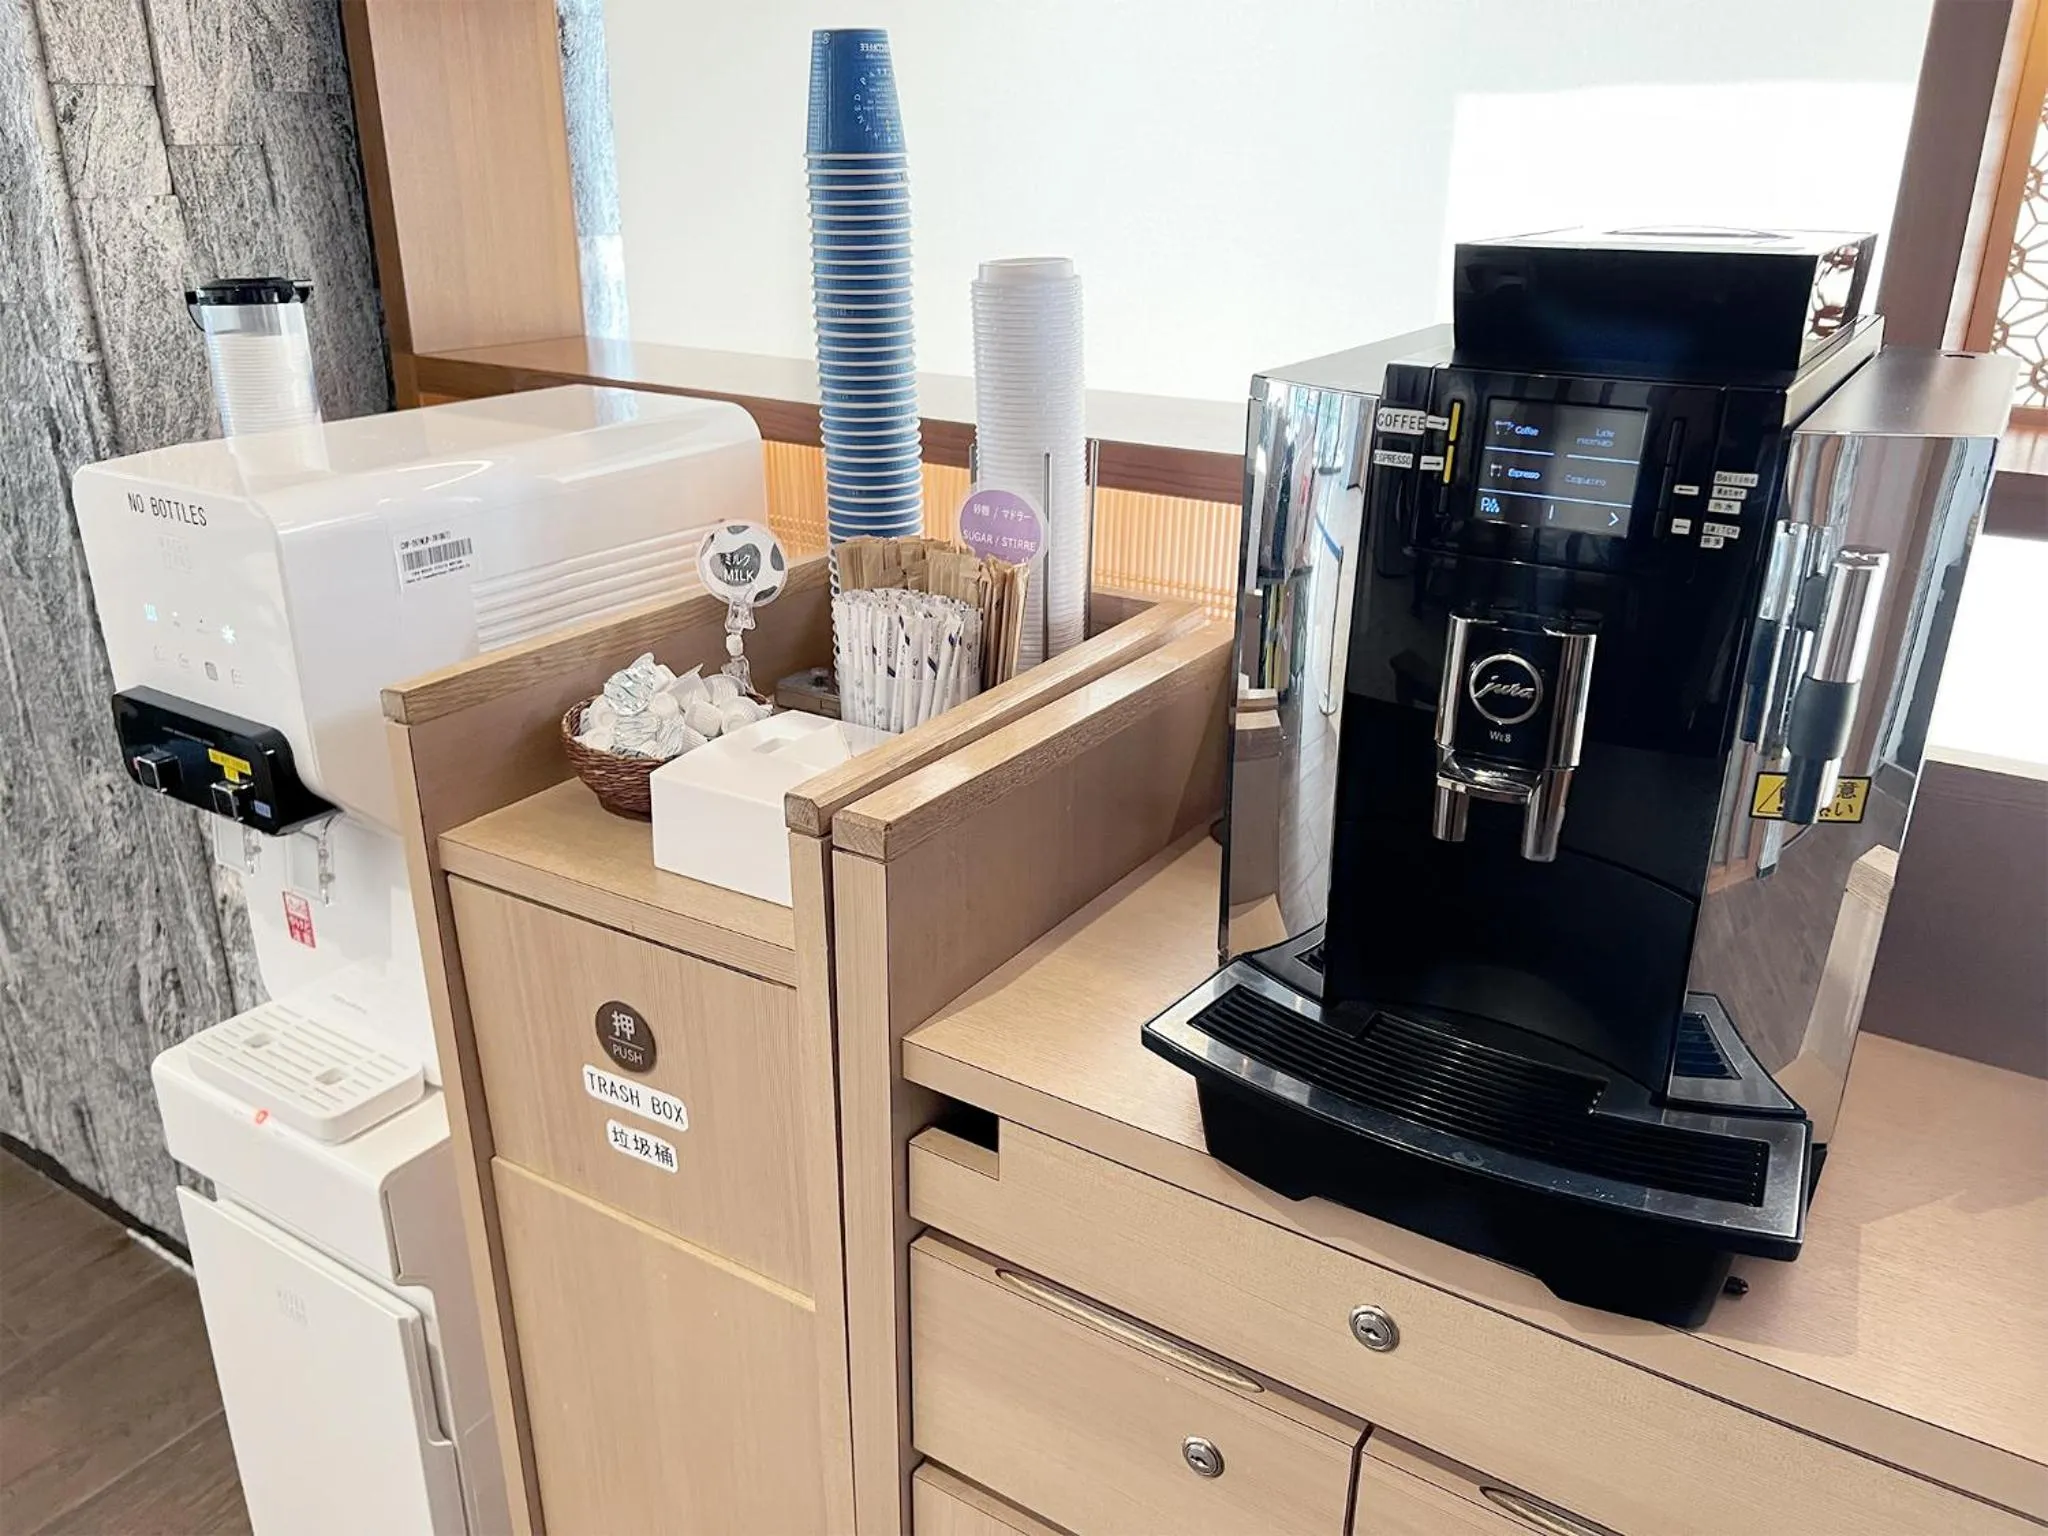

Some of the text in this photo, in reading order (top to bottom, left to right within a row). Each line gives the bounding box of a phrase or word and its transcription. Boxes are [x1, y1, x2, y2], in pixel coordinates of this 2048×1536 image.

[1378, 413, 1425, 430] COFFEE
[1375, 453, 1411, 465] ESPRESSO
[128, 492, 207, 527] NO BOTTLES
[963, 529, 993, 545] SUGAR
[724, 568, 755, 581] MILK
[1474, 675, 1535, 699] jura
[612, 1010, 636, 1041] 押
[613, 1043, 643, 1065] PUSH
[587, 1072, 684, 1125] TRASH BOX
[612, 1126, 674, 1168] 垃圾桶
